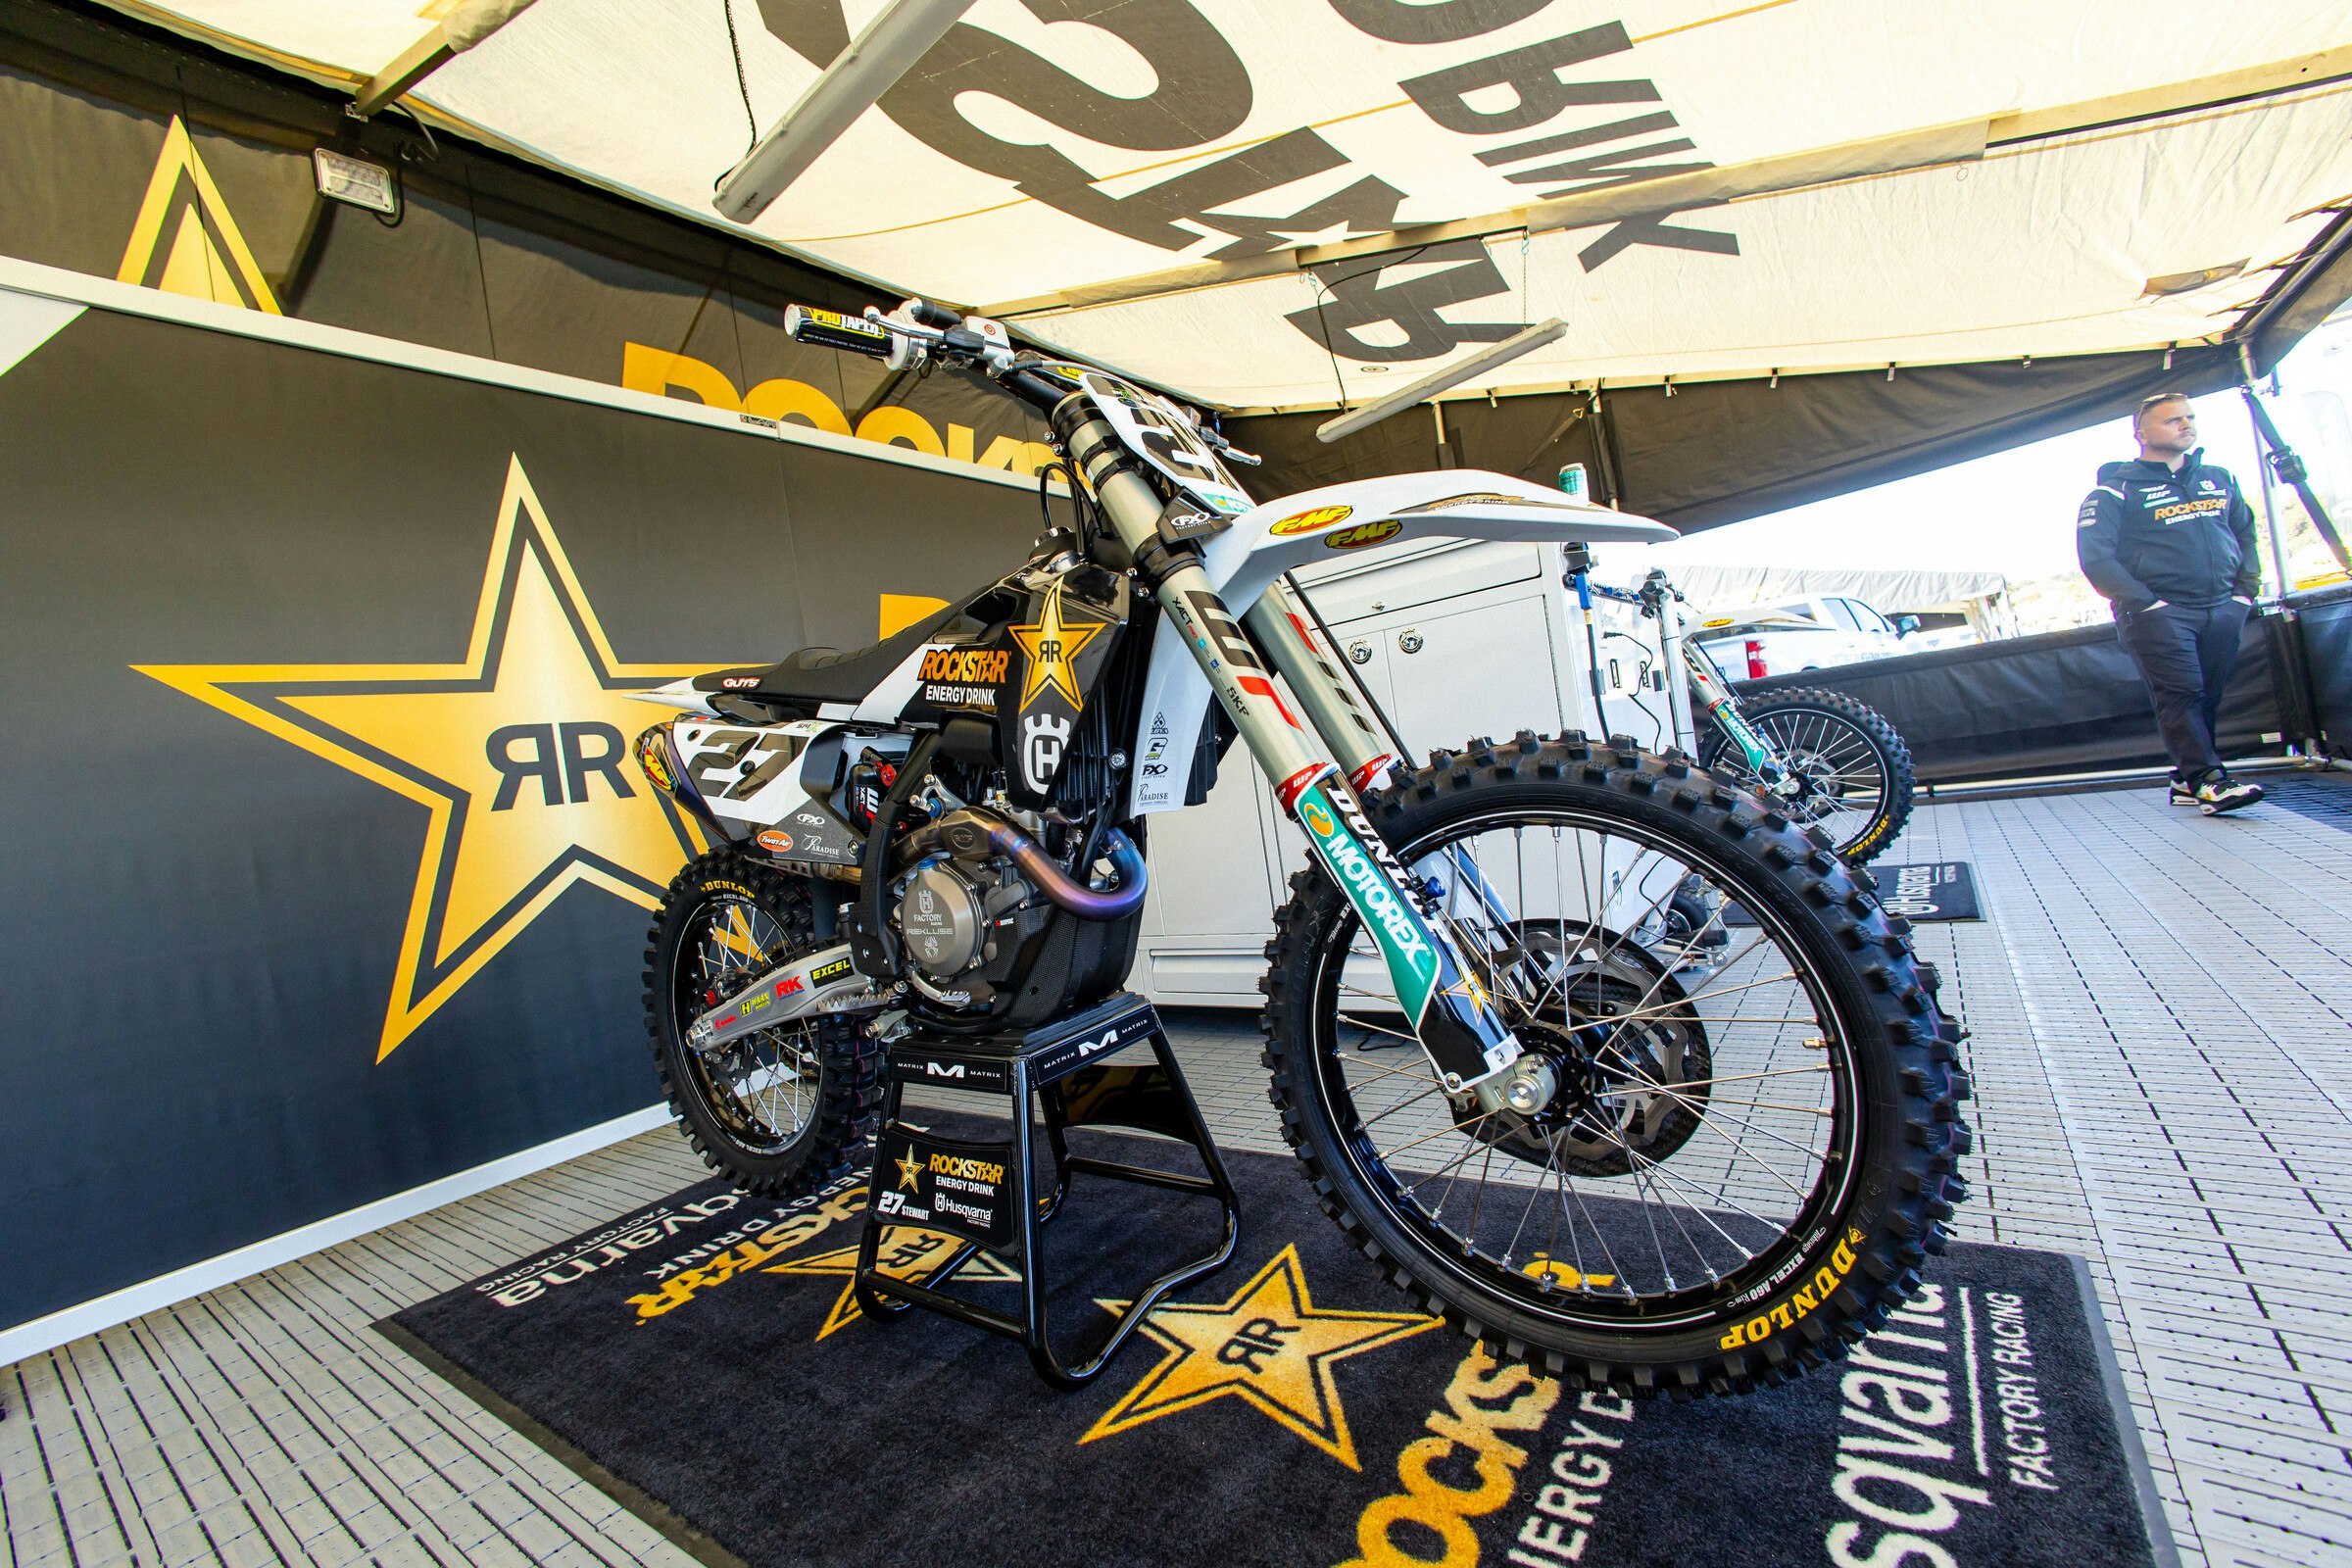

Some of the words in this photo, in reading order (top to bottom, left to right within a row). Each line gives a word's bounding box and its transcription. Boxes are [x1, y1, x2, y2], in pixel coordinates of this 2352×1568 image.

[2155, 499, 2228, 520] ROCKSTAR
[2165, 512, 2200, 524] ENERGY
[1172, 596, 1194, 626] XACT
[917, 649, 1009, 684] ROCKSTAR
[722, 677, 760, 689] GUTS
[925, 684, 965, 704] ENERGY
[965, 686, 997, 707] DRINK
[1226, 686, 1250, 716] SKF
[1138, 784, 1169, 802] PARADISE
[760, 835, 778, 846] Twin
[802, 833, 840, 856] PARADISE
[1328, 787, 1451, 946] DUNLOP
[705, 880, 756, 900] DUNLOP
[913, 913, 942, 922] FACTORY
[1326, 833, 1433, 981] MOTOREX
[811, 959, 851, 981] EXCEL
[751, 991, 770, 1007] HAAN
[775, 975, 804, 999] RK
[1044, 1052, 1076, 1069] MATRIX
[1121, 1018, 1149, 1034] MATRIX
[970, 1070, 1002, 1079] MATRIX
[929, 1153, 1004, 1185] ROCKSTAR
[936, 1176, 967, 1192] ENERGY
[967, 1179, 995, 1197] DRINK
[877, 1191, 906, 1215] 27
[902, 1205, 930, 1221] STEWART
[946, 1198, 993, 1221] Husqvarna
[573, 1206, 669, 1255] FACTORY
[492, 1189, 741, 1308] qvarna
[624, 1186, 870, 1319] CKSTAR
[643, 1219, 771, 1280] DRINK
[474, 1251, 568, 1294] RACING
[1770, 1251, 1806, 1284] EXCEL
[1720, 1238, 1858, 1350] DUNLOP
[1749, 1282, 1772, 1301] A60
[1985, 1292, 2033, 1367] RACING
[1995, 1366, 2059, 1492] FACTORY
